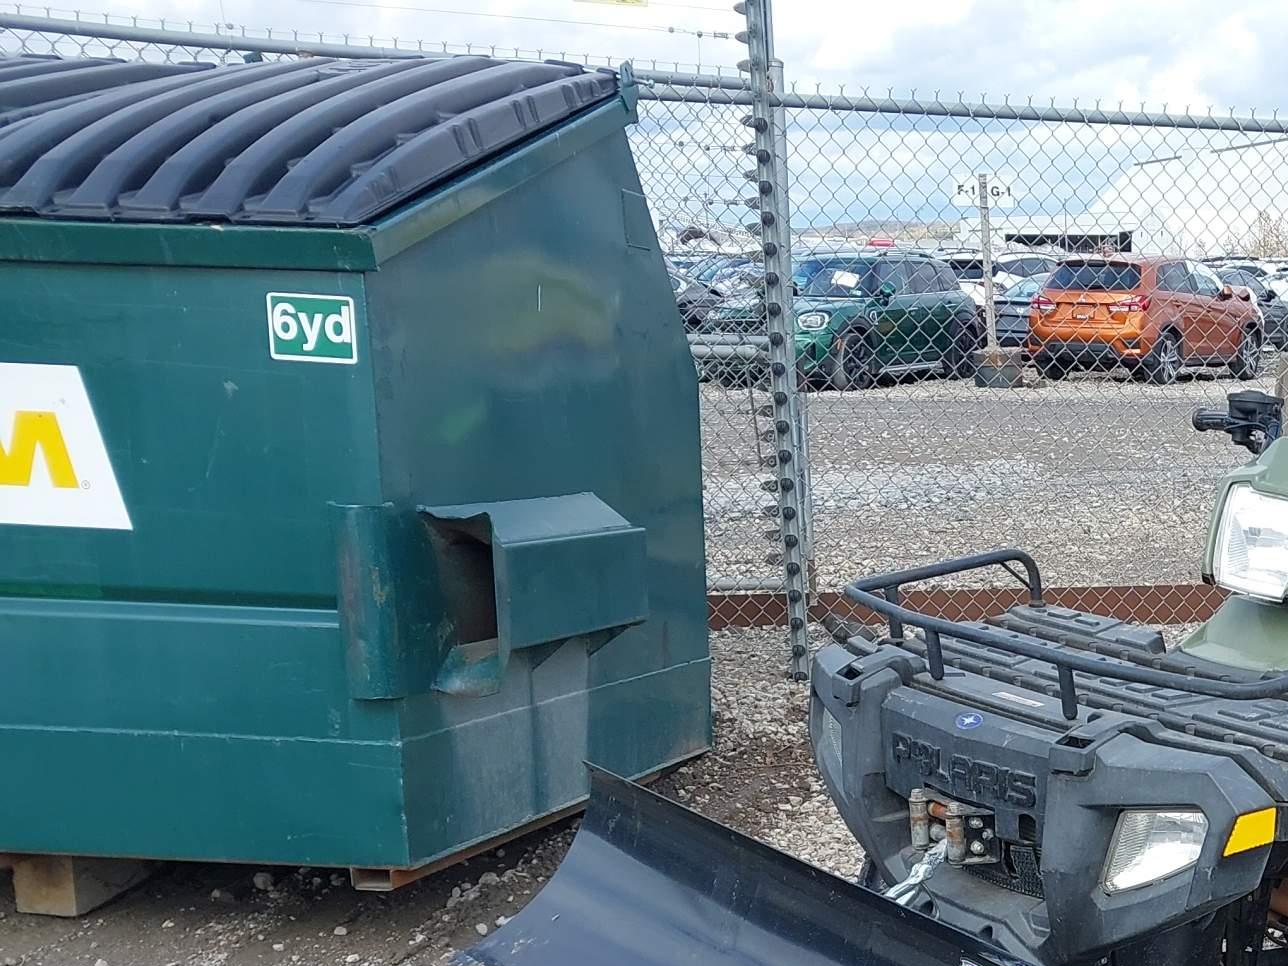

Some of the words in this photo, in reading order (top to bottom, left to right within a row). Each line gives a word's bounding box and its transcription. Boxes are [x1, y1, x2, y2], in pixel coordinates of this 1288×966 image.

[957, 184, 975, 195] F-1
[990, 186, 1011, 197] G-1
[272, 302, 352, 351] 6yd
[891, 731, 1037, 808] POLARIS
